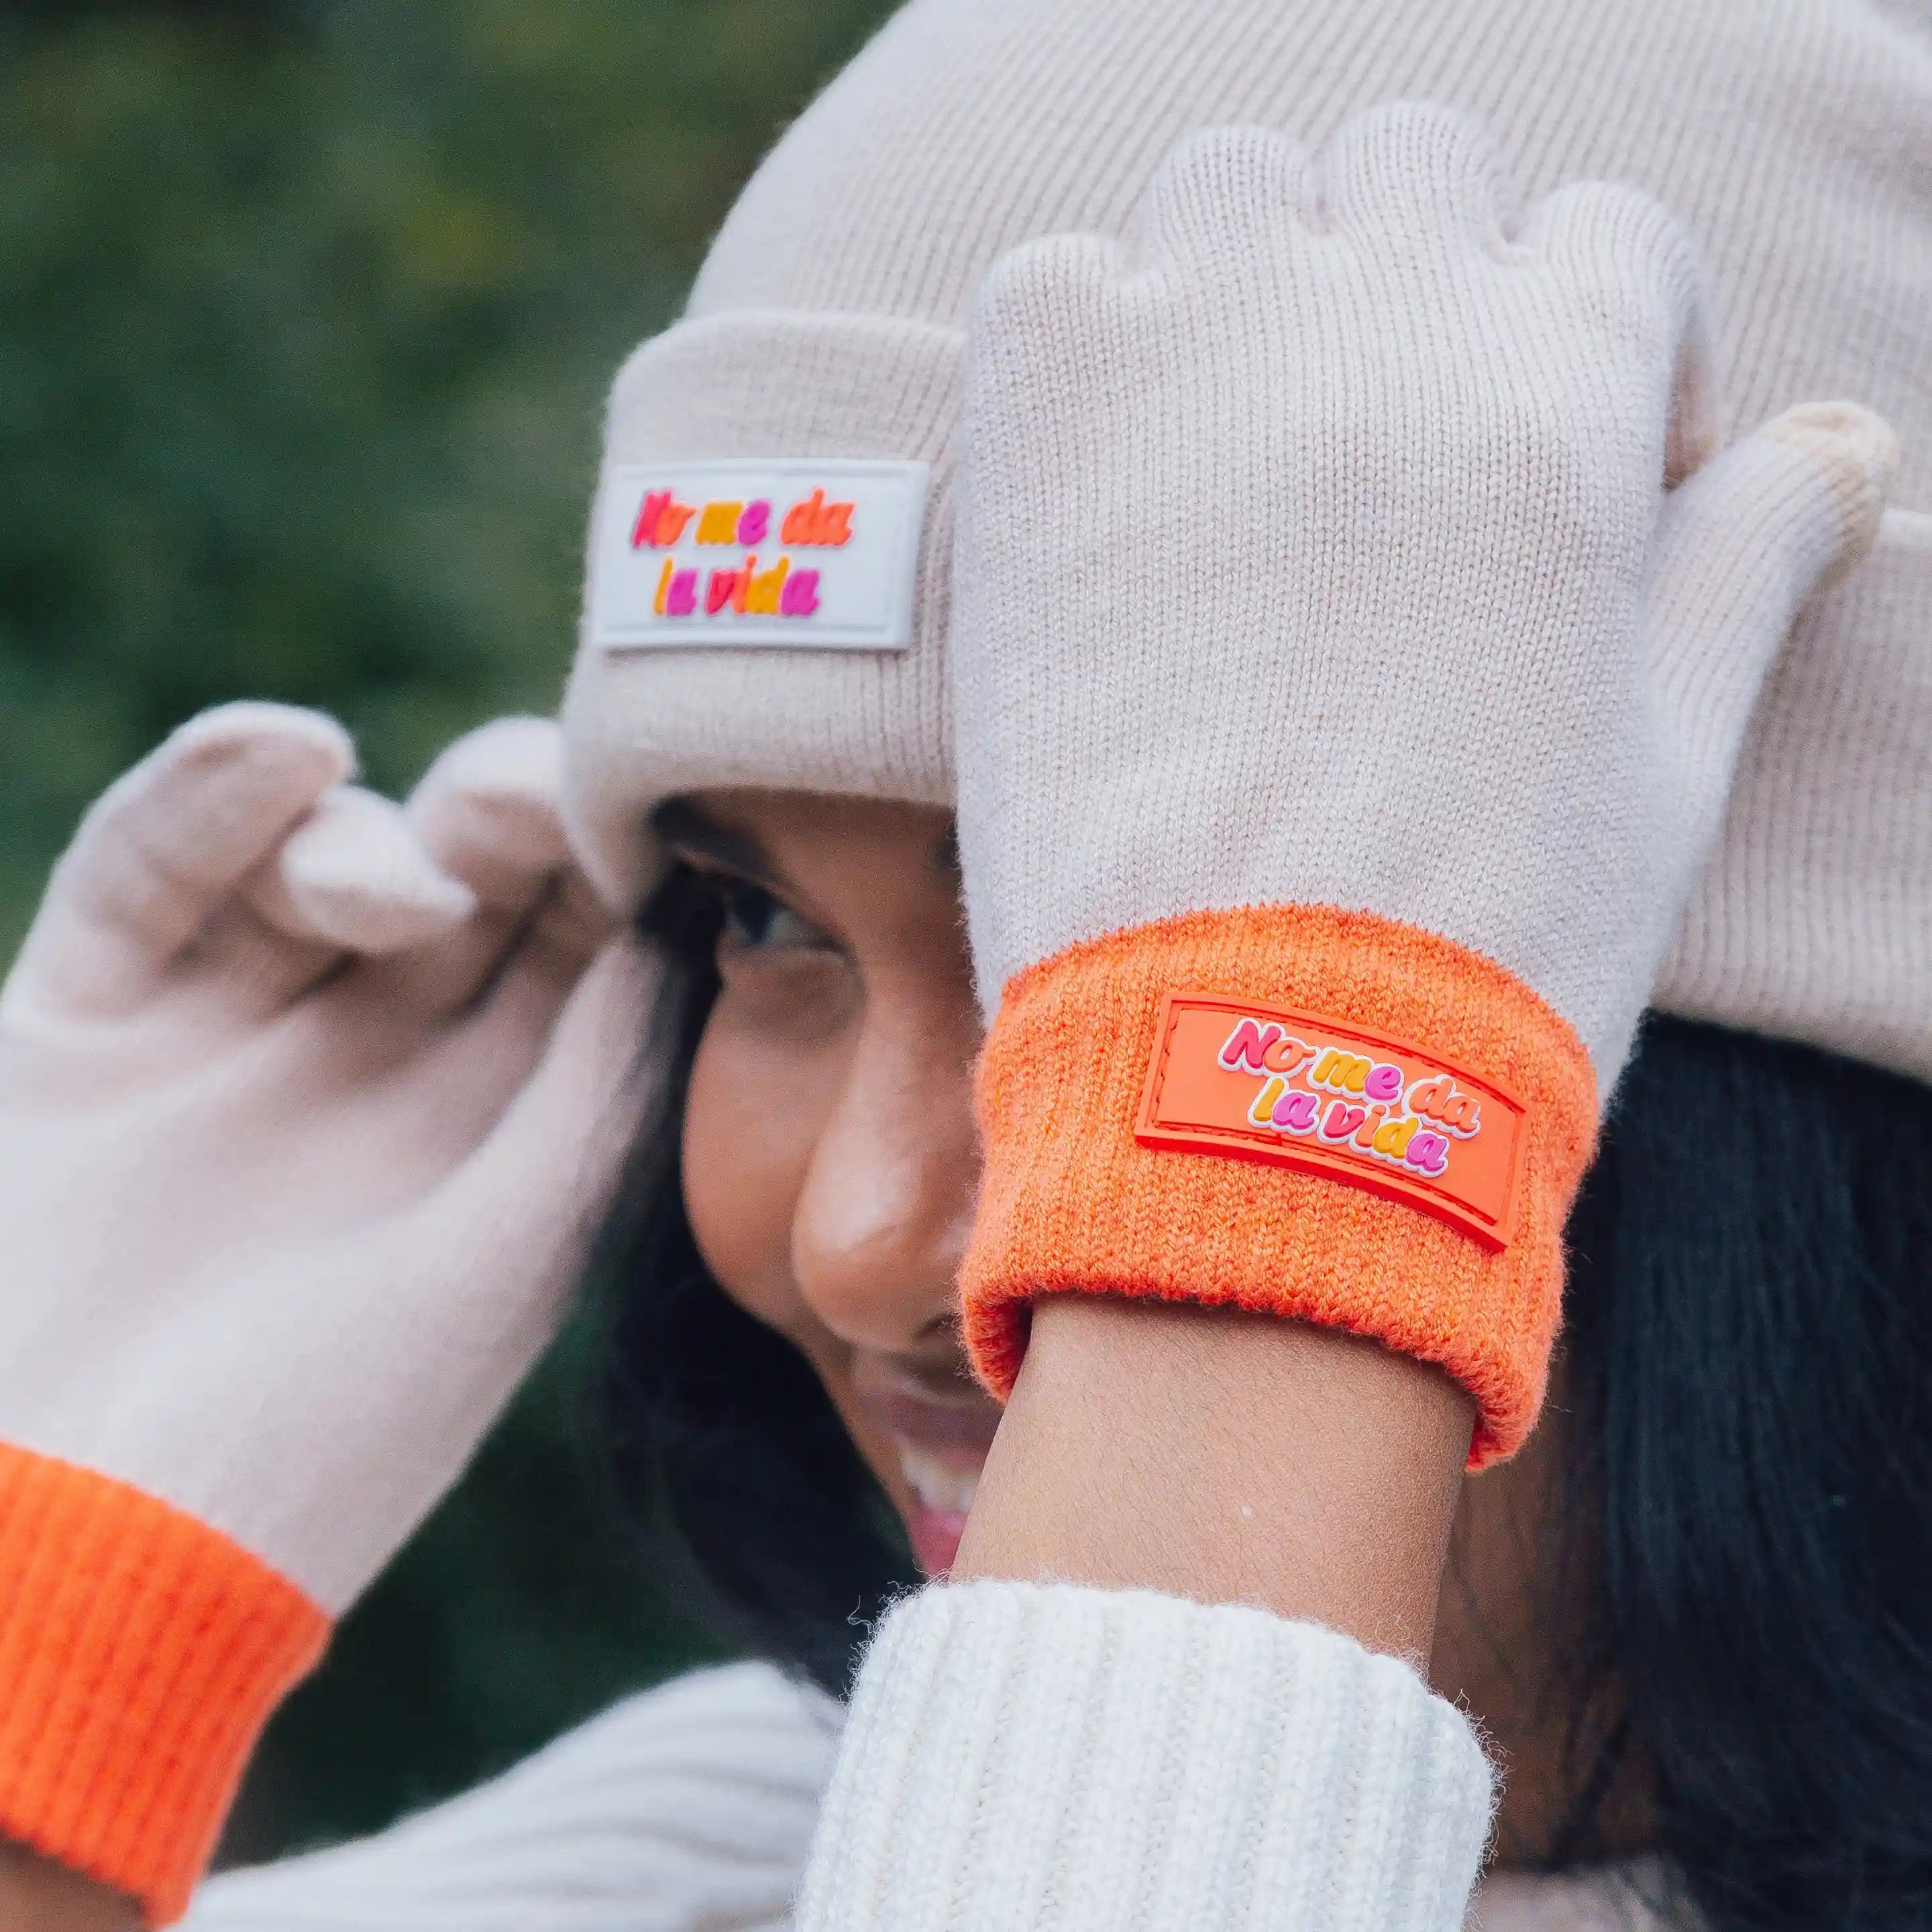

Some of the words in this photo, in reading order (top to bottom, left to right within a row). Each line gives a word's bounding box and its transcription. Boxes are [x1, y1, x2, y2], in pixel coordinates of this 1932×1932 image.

[780, 487, 855, 547] da
[653, 555, 698, 616] la
[706, 553, 820, 616] vida
[1220, 1019, 1319, 1075] No
[1309, 1048, 1403, 1104] me
[1405, 1077, 1481, 1136] da
[1249, 1078, 1319, 1133] la
[1319, 1102, 1450, 1176] vida
